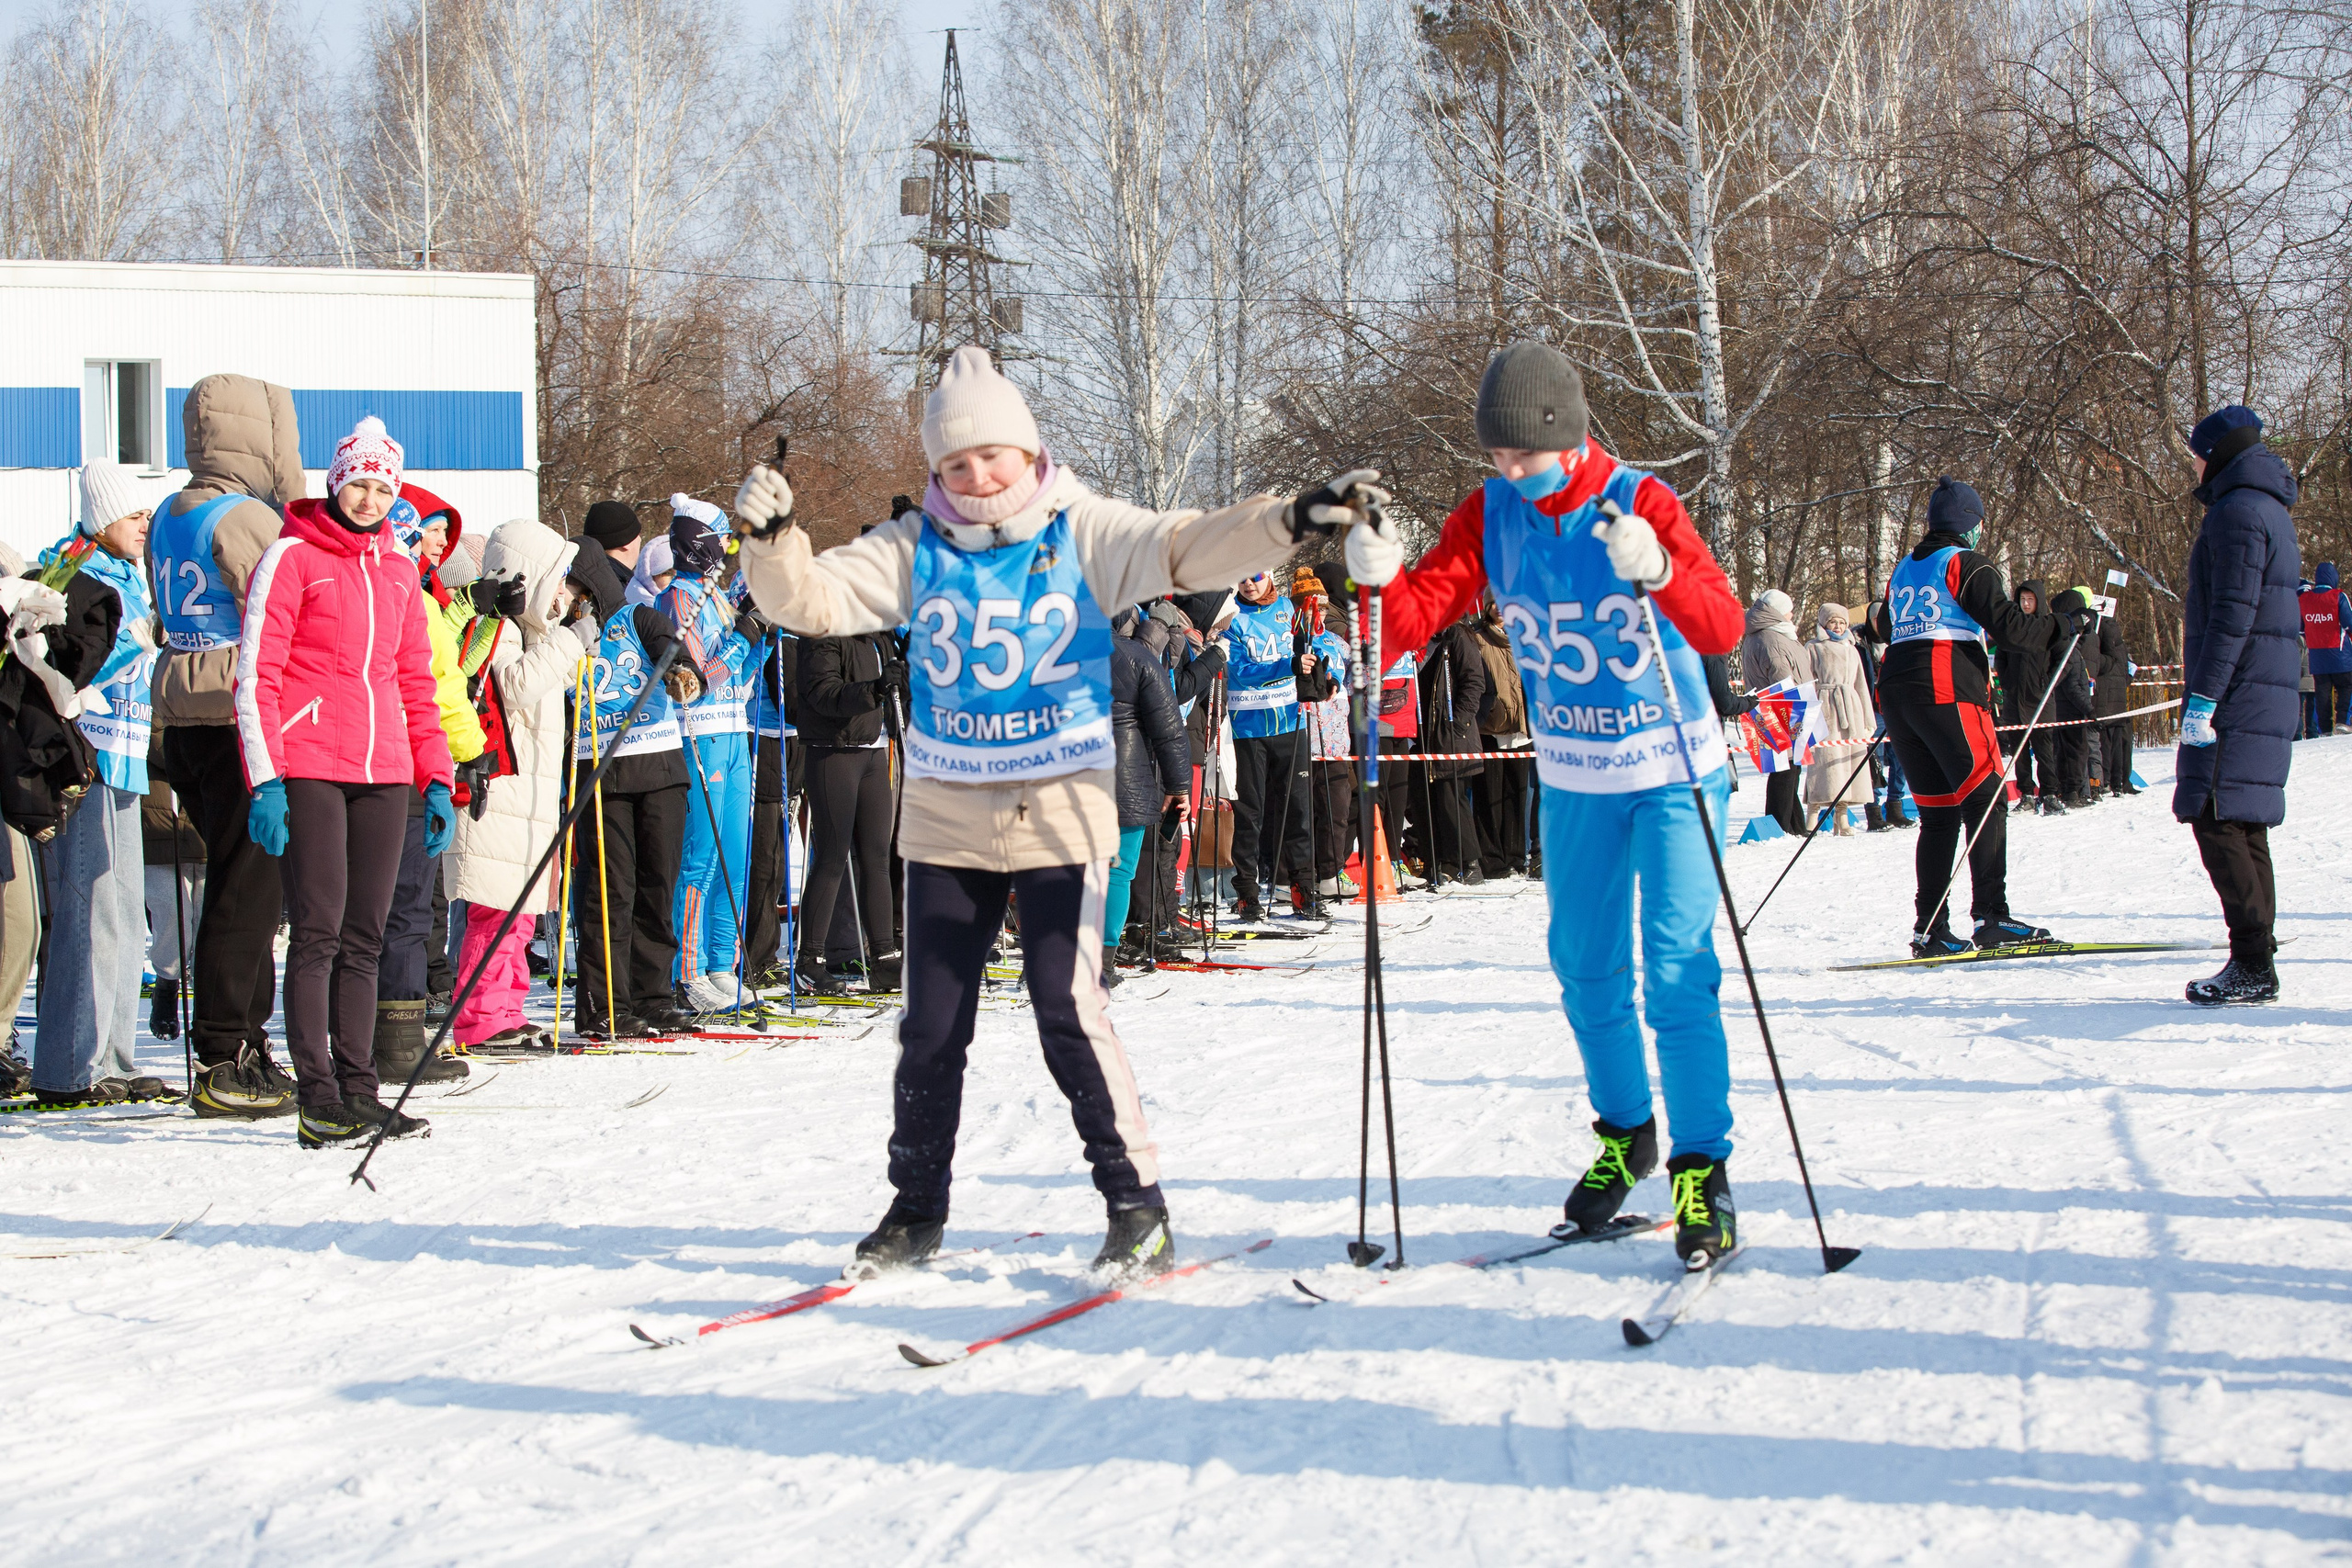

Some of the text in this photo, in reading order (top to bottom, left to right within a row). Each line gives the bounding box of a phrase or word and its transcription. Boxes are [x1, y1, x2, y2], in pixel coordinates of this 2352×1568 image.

[152, 556, 214, 616] 12
[2305, 614, 2334, 624] СУДЬЯ
[919, 592, 1080, 691] 352
[1348, 599, 1364, 689] NORDWAY
[1503, 592, 1654, 685] 353
[570, 650, 650, 708] 23
[75, 721, 113, 737] КУБОК
[116, 728, 142, 741] ГЛАВЫ
[644, 728, 677, 740] ТЮМЕНИ
[930, 704, 1076, 742] ТЮМЕНЬ
[1535, 699, 1664, 735] ТЮМЕНЬ
[934, 755, 980, 773] ГЛАВЫ
[988, 750, 1056, 773] ГОРОДА
[1588, 750, 1647, 771] ГОРОДА
[1977, 944, 2074, 958] FISCHER
